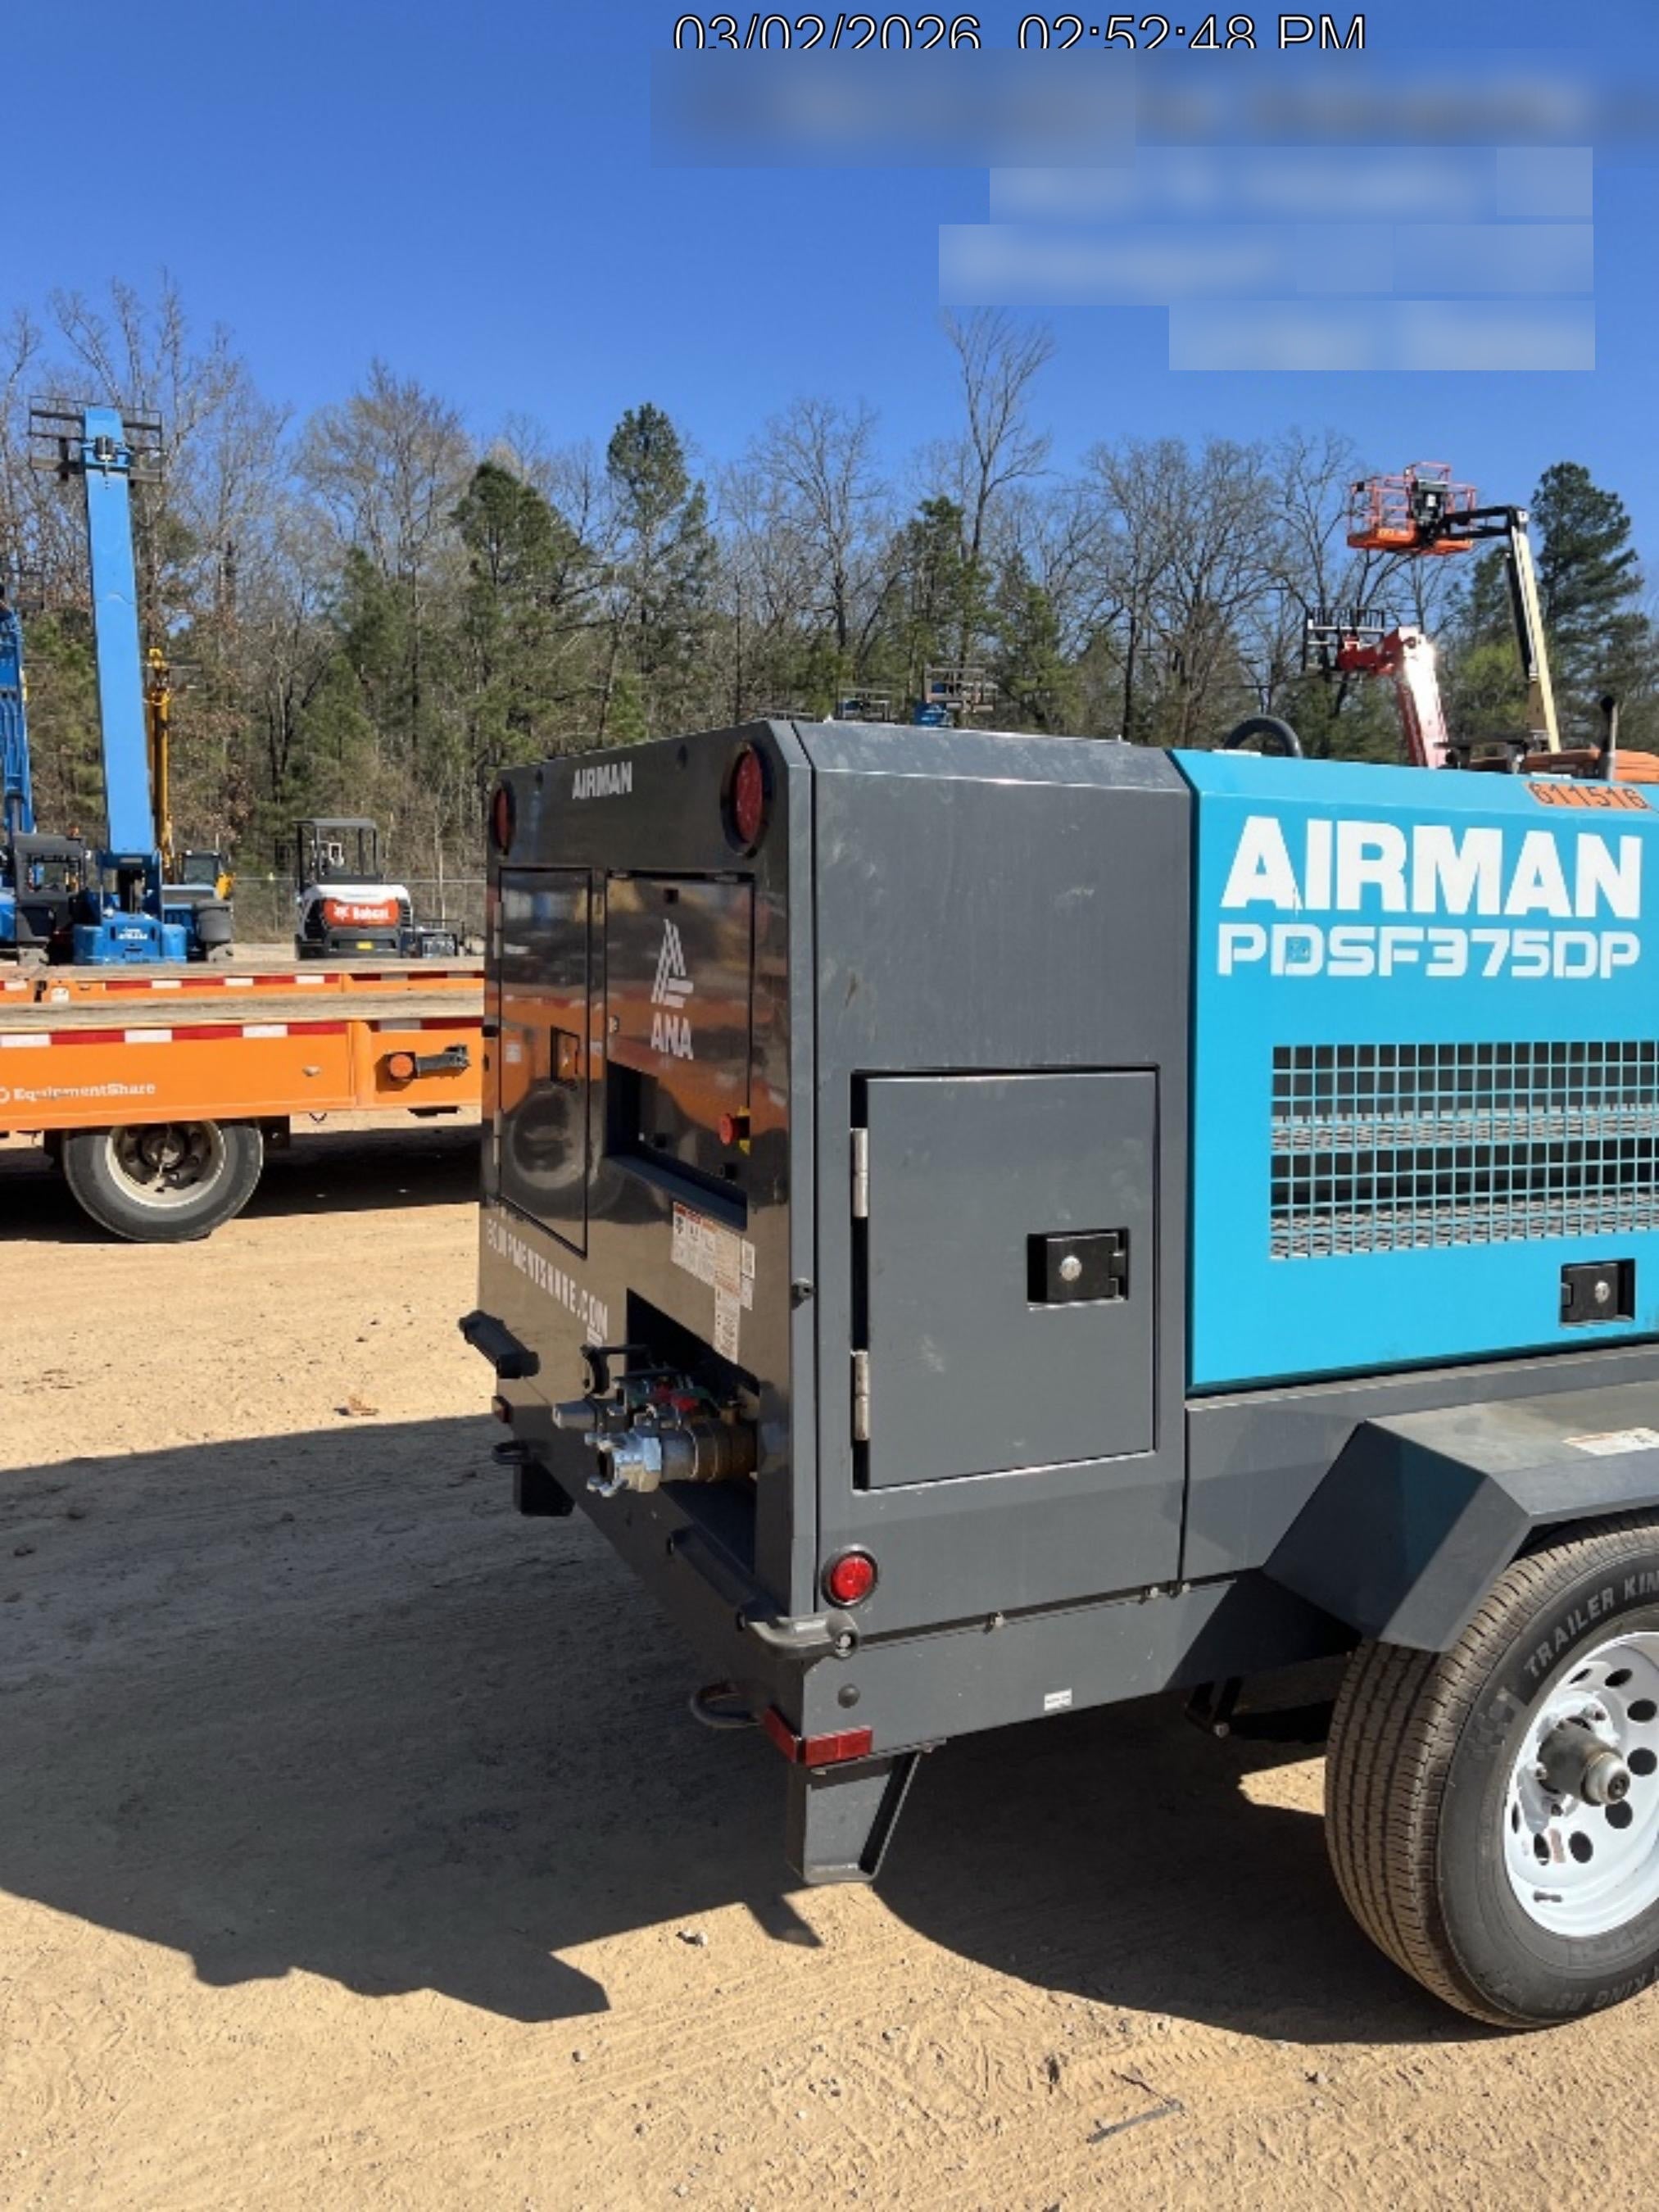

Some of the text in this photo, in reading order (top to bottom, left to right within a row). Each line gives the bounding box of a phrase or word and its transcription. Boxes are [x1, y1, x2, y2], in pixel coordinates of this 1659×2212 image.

[572, 760, 632, 800] AIRMAN
[1528, 781, 1652, 809] 611516
[1220, 815, 1643, 919] AIRMAN
[1217, 922, 1641, 979] PDSF375DP
[650, 1012, 694, 1059] ANA
[13, 1081, 156, 1103] EquipmentShare
[1523, 1587, 1616, 1677] TRAILER
